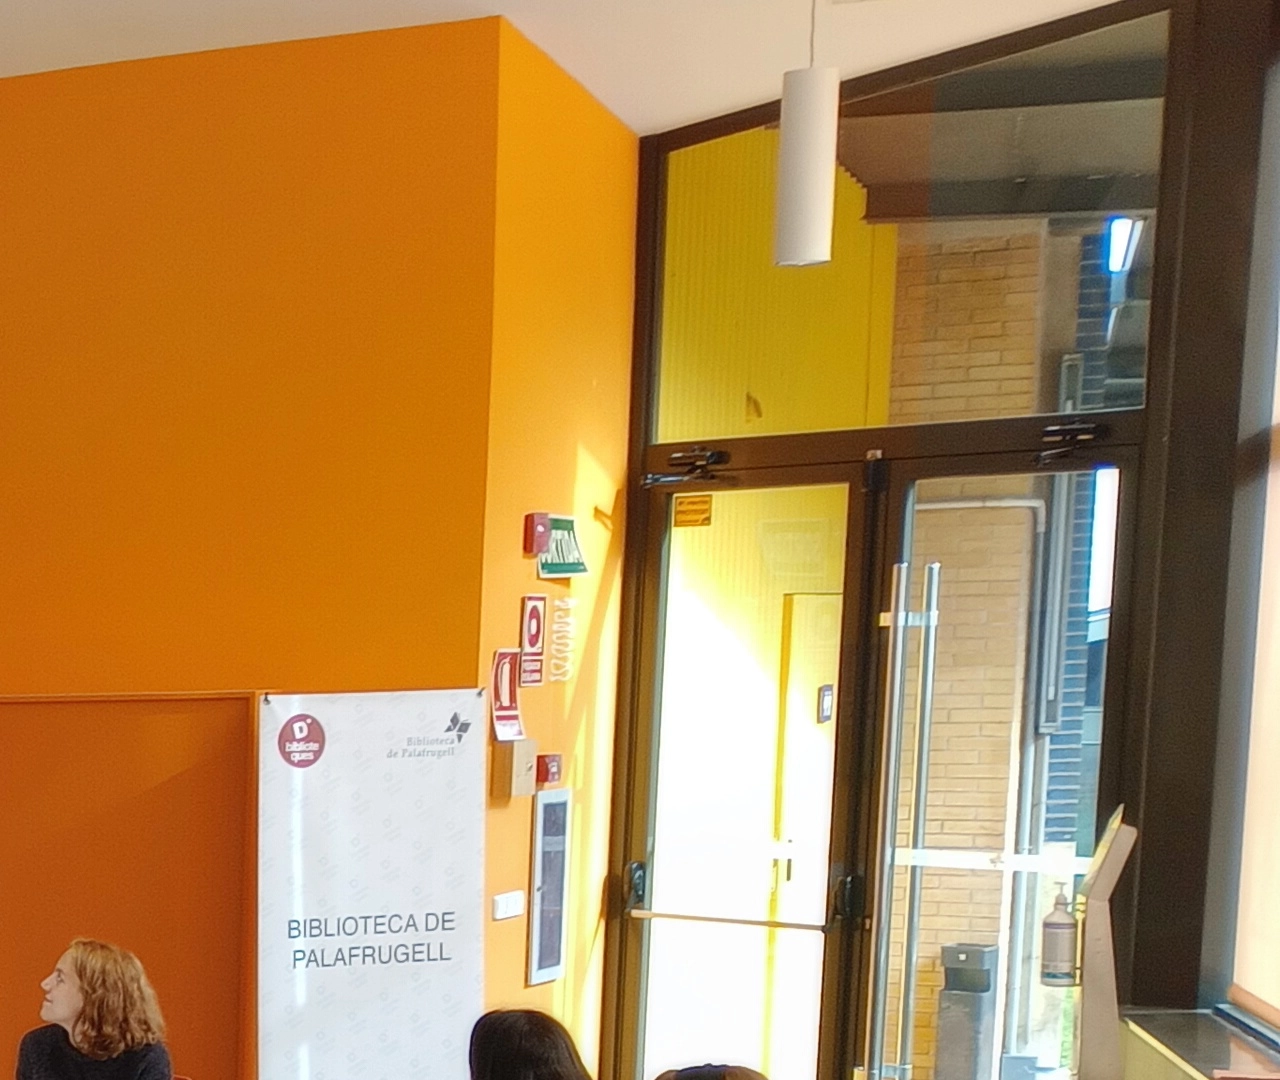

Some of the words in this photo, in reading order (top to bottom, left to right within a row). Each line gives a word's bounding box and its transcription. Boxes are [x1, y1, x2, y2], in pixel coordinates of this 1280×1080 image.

[406, 736, 455, 747] Biblioteca
[386, 749, 398, 759] de
[401, 747, 455, 759] Palafrugell
[287, 913, 419, 939] BIBLIOTECA
[424, 911, 456, 932] DE
[292, 941, 453, 970] PALAFRUGELL
